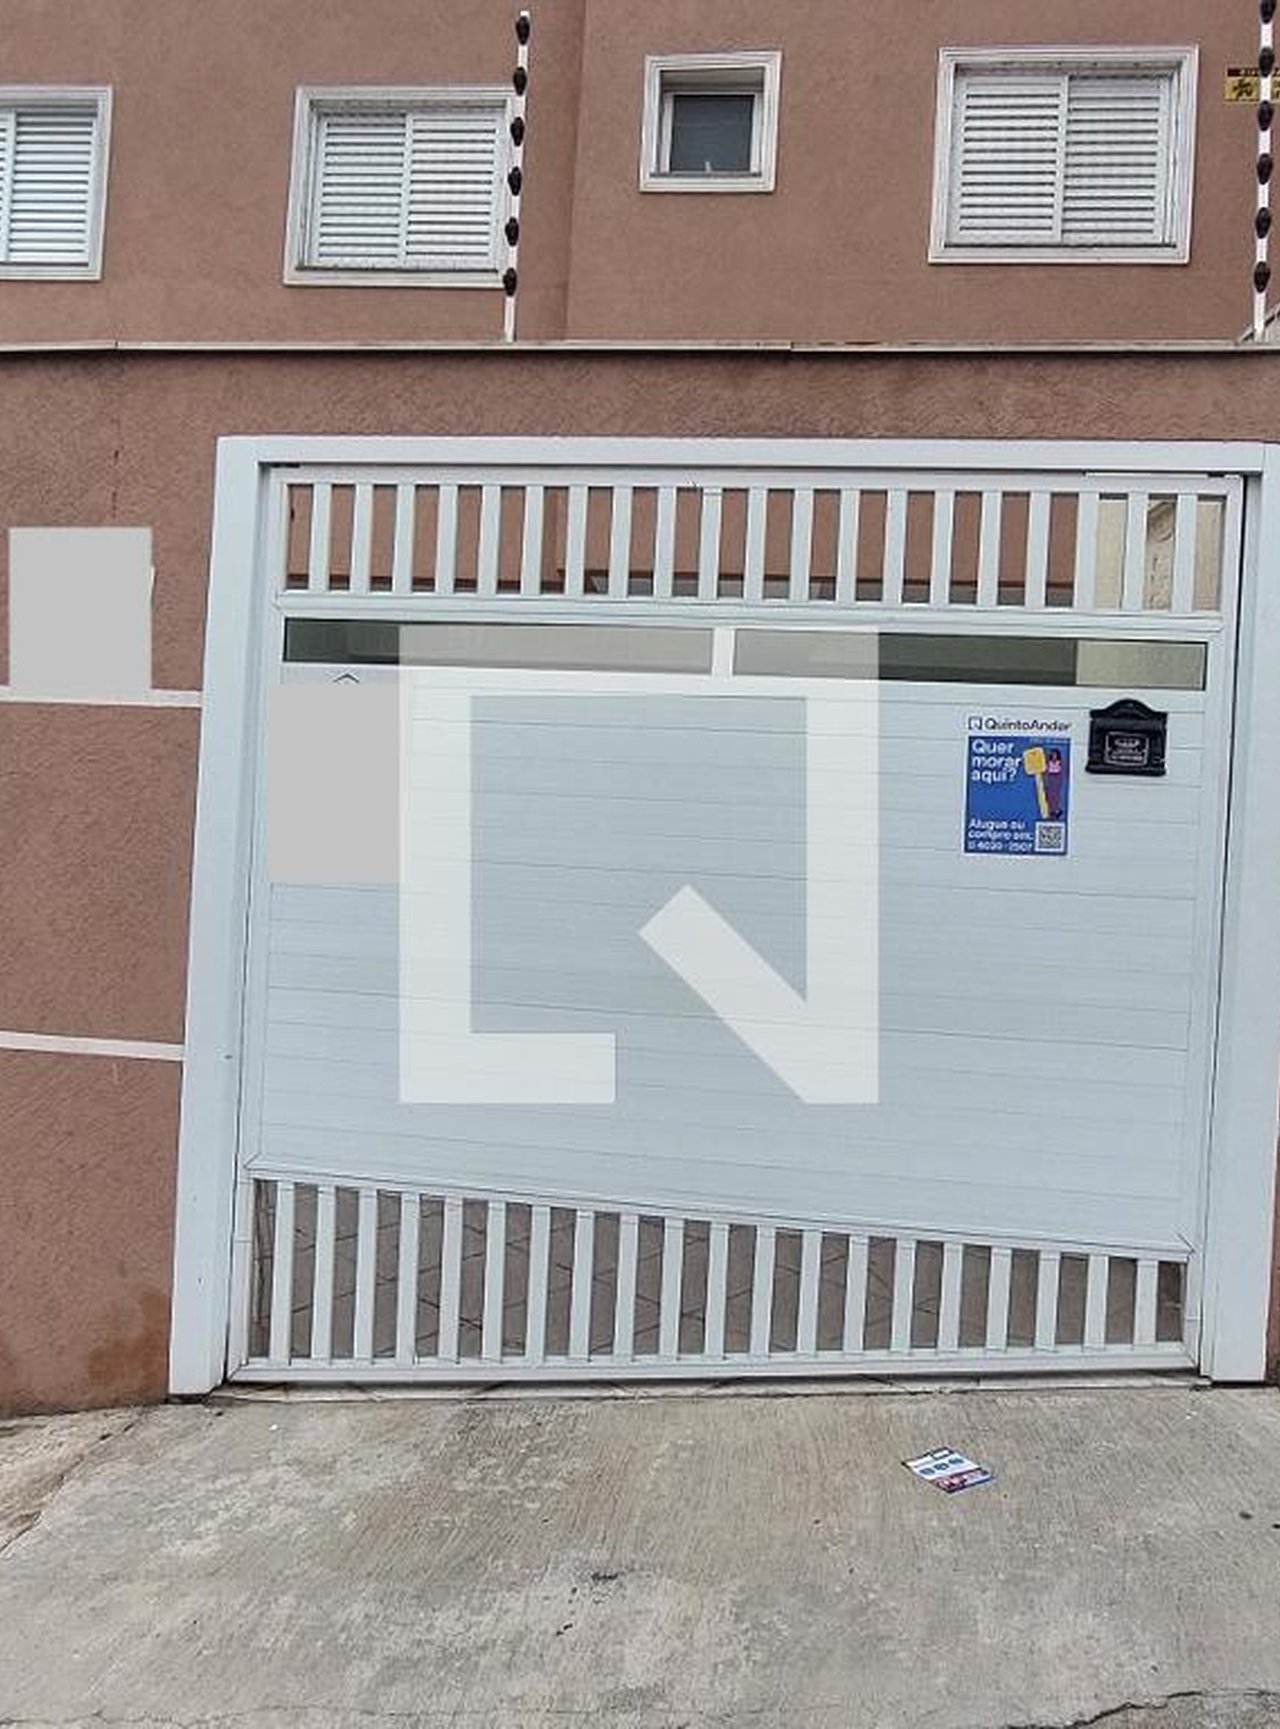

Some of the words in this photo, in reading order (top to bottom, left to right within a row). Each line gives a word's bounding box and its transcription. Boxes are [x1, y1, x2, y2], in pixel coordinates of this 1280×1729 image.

[972, 739, 1014, 754] Quer
[972, 755, 1022, 768] morar
[971, 767, 1017, 784] aqui?
